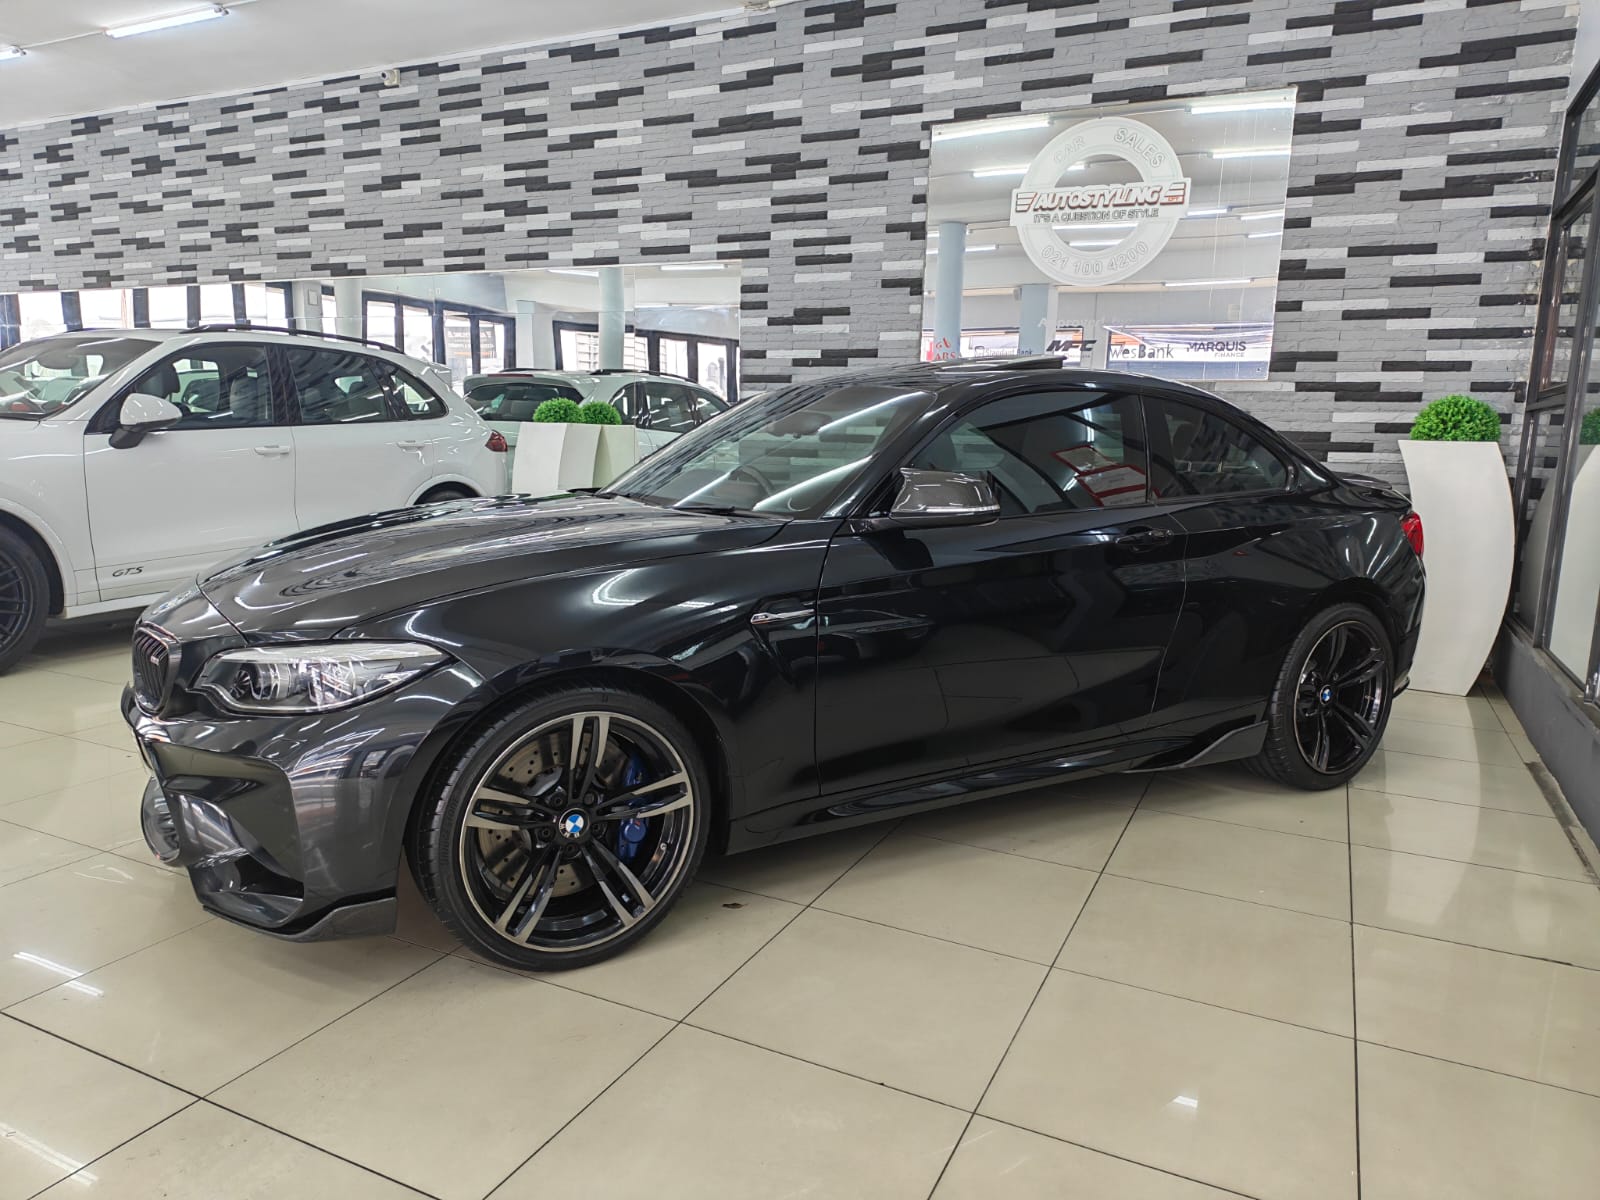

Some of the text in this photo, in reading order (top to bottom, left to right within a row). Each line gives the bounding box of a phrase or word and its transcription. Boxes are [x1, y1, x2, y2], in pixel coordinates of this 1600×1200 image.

[1053, 128, 1166, 168] CAR SALES
[1033, 184, 1162, 211] AUTOSTYLING
[1061, 211, 1110, 222] QUESTION
[1112, 209, 1127, 220] OF
[1128, 208, 1159, 219] STYLE
[1041, 241, 1149, 275] 021 100 4200
[1046, 340, 1097, 352] MFC
[1109, 343, 1174, 359] WesBank
[1186, 341, 1247, 352] MARQUIS
[112, 566, 144, 577] GTS
